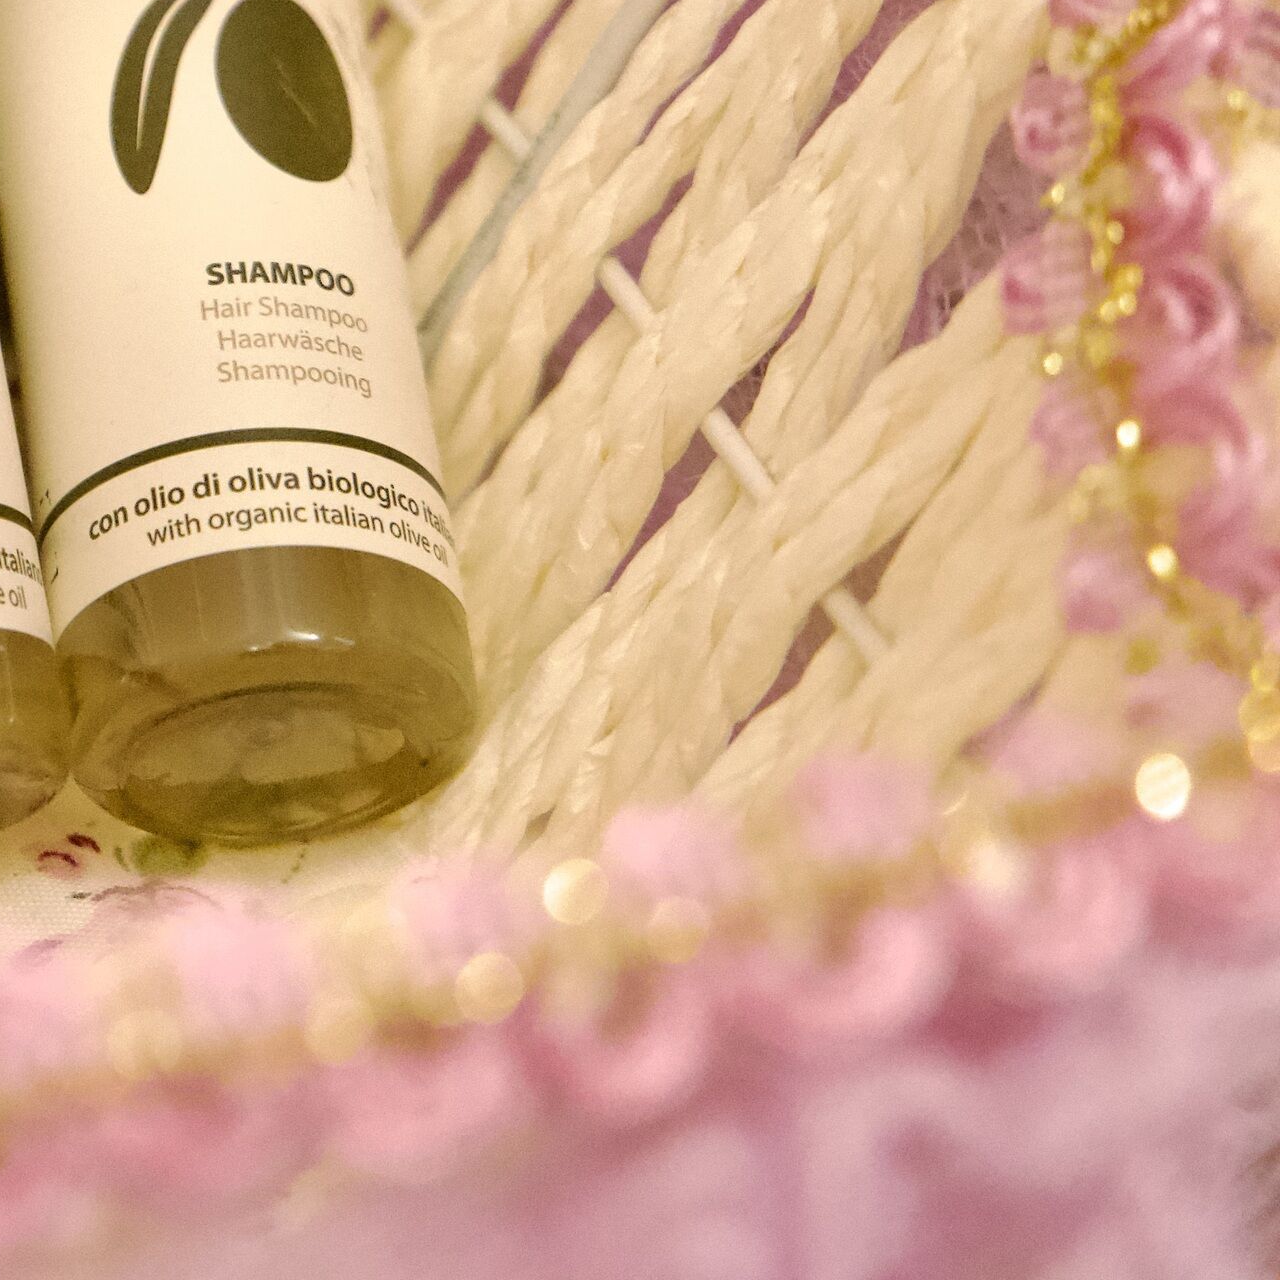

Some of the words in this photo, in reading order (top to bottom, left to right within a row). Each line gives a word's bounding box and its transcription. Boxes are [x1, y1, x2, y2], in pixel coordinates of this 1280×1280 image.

[205, 260, 355, 297] SHAMPOO
[200, 297, 252, 321] Hair
[258, 295, 368, 333] Shampoo
[217, 328, 364, 361] Haarwäsche
[217, 360, 372, 398] Shampooing
[88, 504, 129, 541] con
[133, 484, 185, 517] olio
[192, 472, 221, 500] di
[227, 466, 300, 492] oliva
[306, 466, 420, 517] biologico
[146, 512, 202, 547] with
[207, 502, 308, 532] organic
[313, 502, 385, 534] italian
[389, 519, 431, 555] olive
[8, 585, 29, 610] oil
